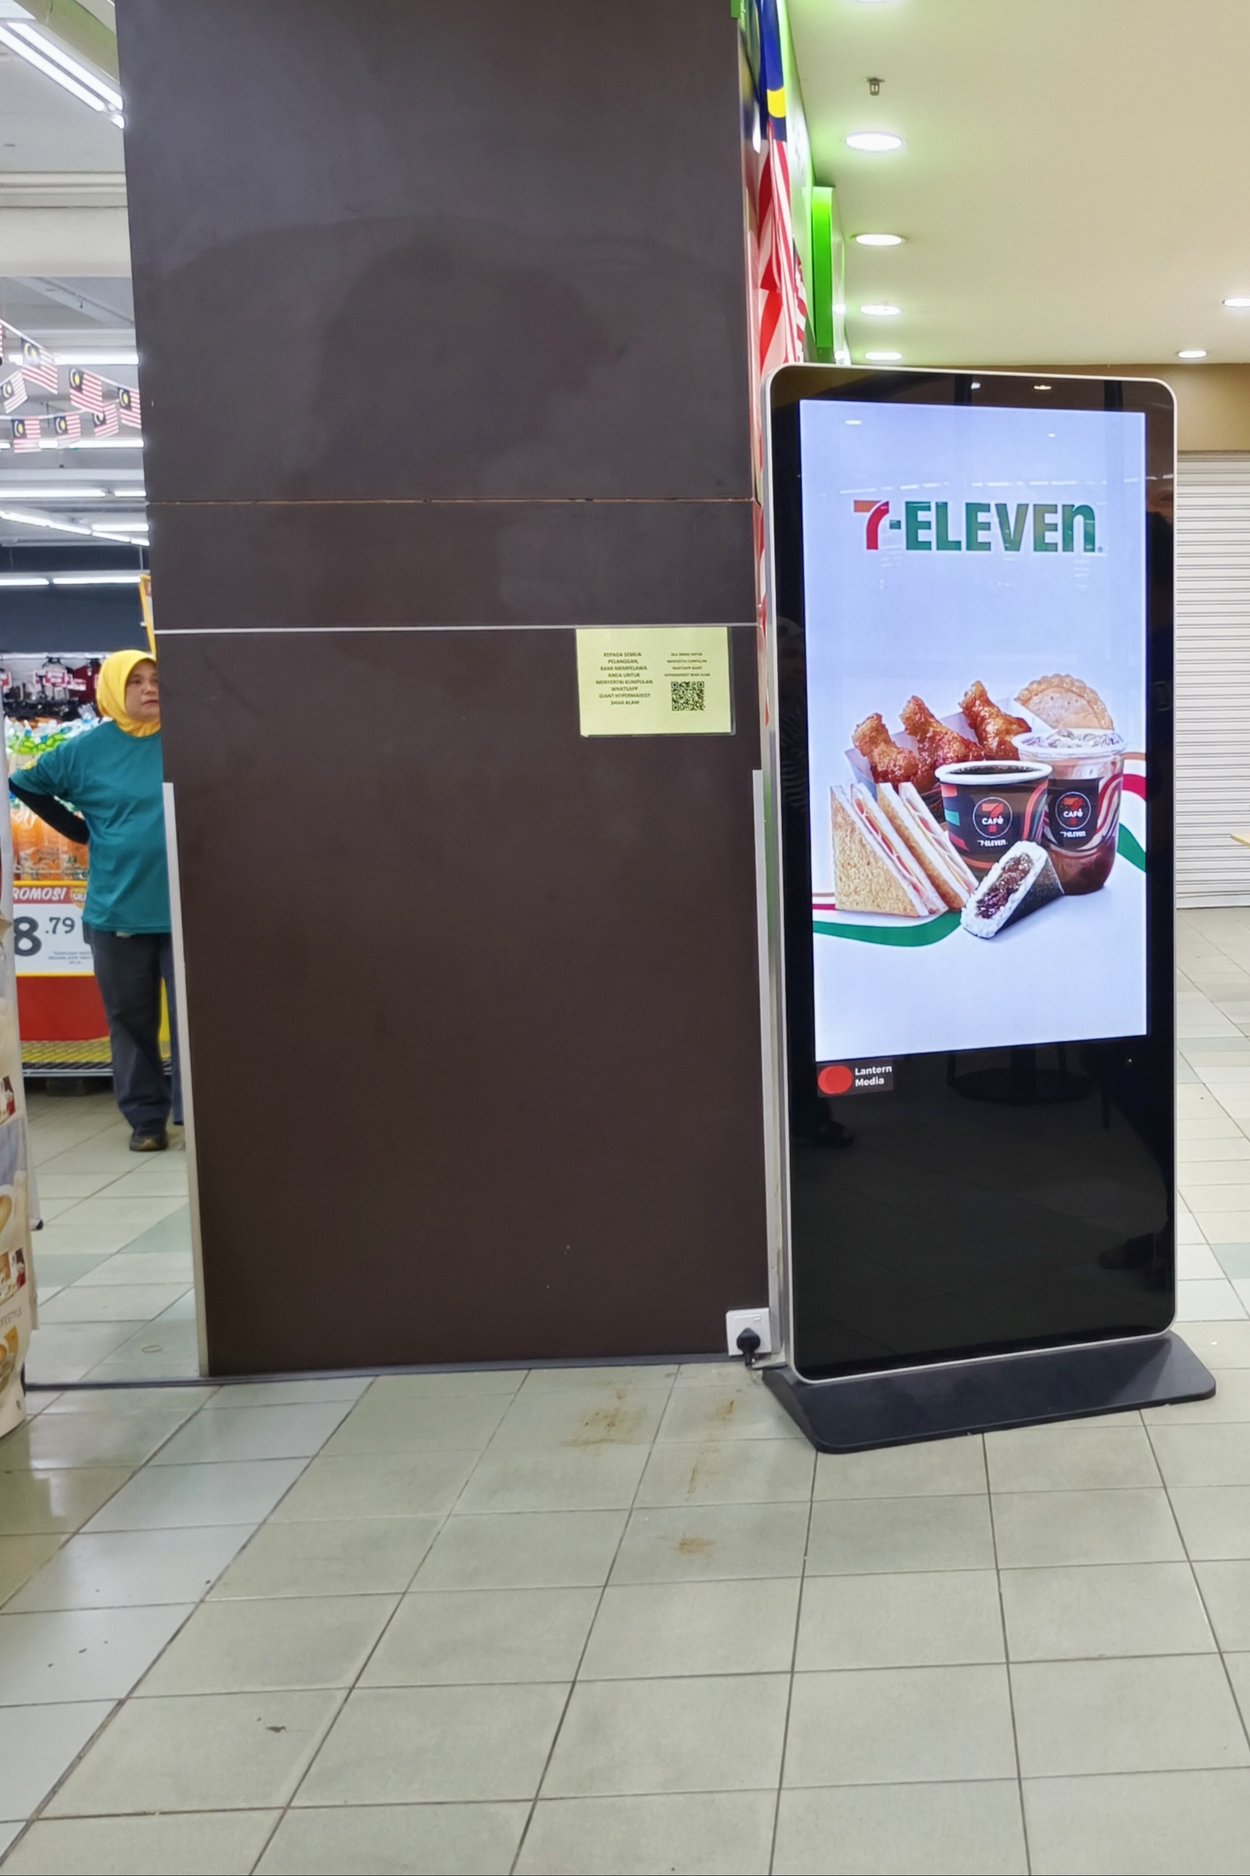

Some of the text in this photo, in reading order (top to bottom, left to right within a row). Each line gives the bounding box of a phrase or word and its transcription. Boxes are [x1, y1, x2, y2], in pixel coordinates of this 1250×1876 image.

[14, 887, 67, 901] ROMOSI
[854, 1065, 893, 1076] Lantern
[855, 1076, 885, 1087] Media
